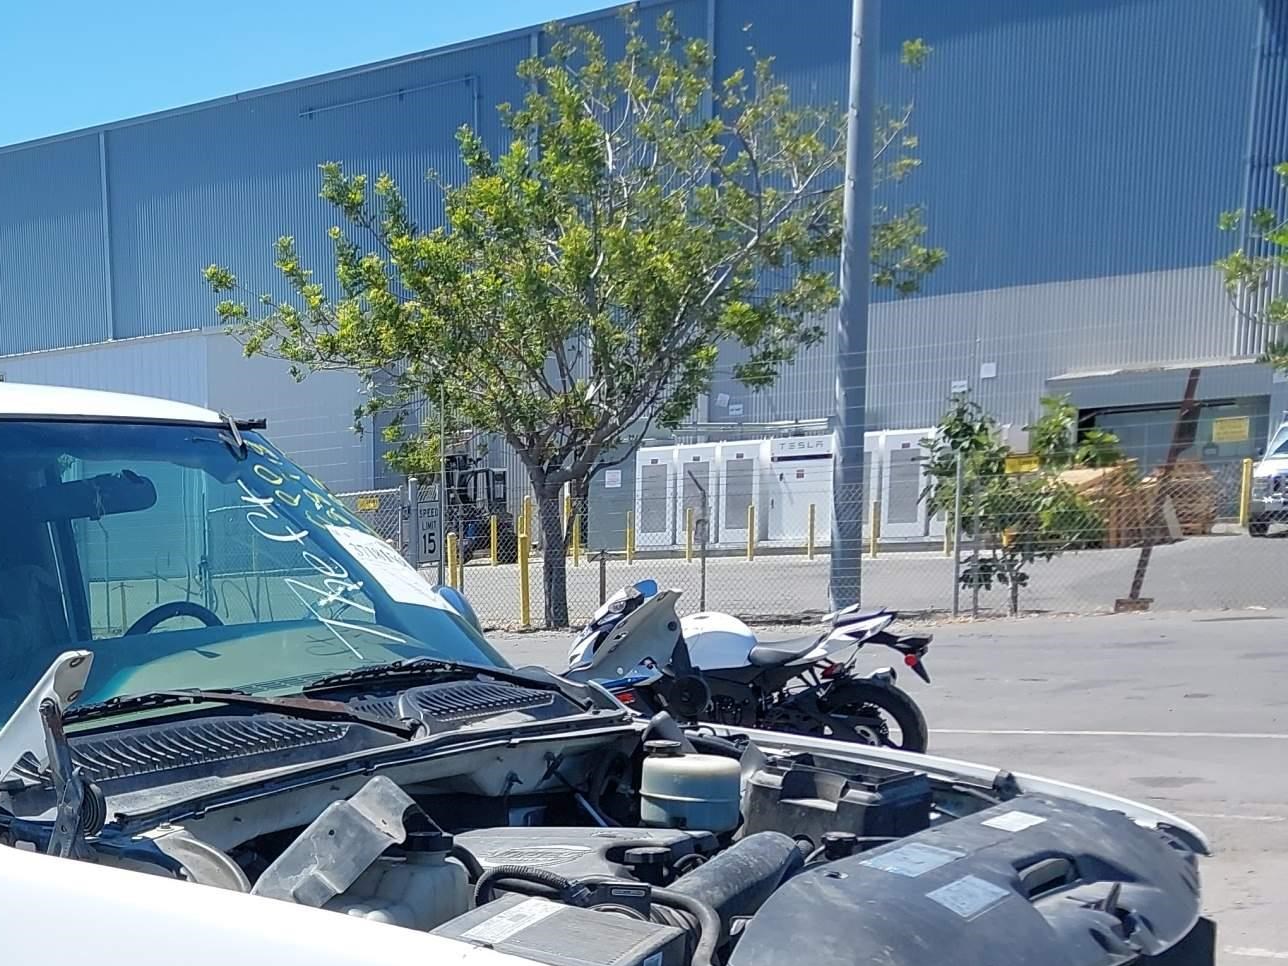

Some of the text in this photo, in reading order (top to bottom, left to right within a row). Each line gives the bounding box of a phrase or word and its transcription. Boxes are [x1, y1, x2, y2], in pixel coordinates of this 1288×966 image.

[778, 440, 824, 450] TESLA
[419, 507, 439, 518] SPEED
[422, 520, 437, 530] LIMIT
[423, 532, 437, 554] 15
